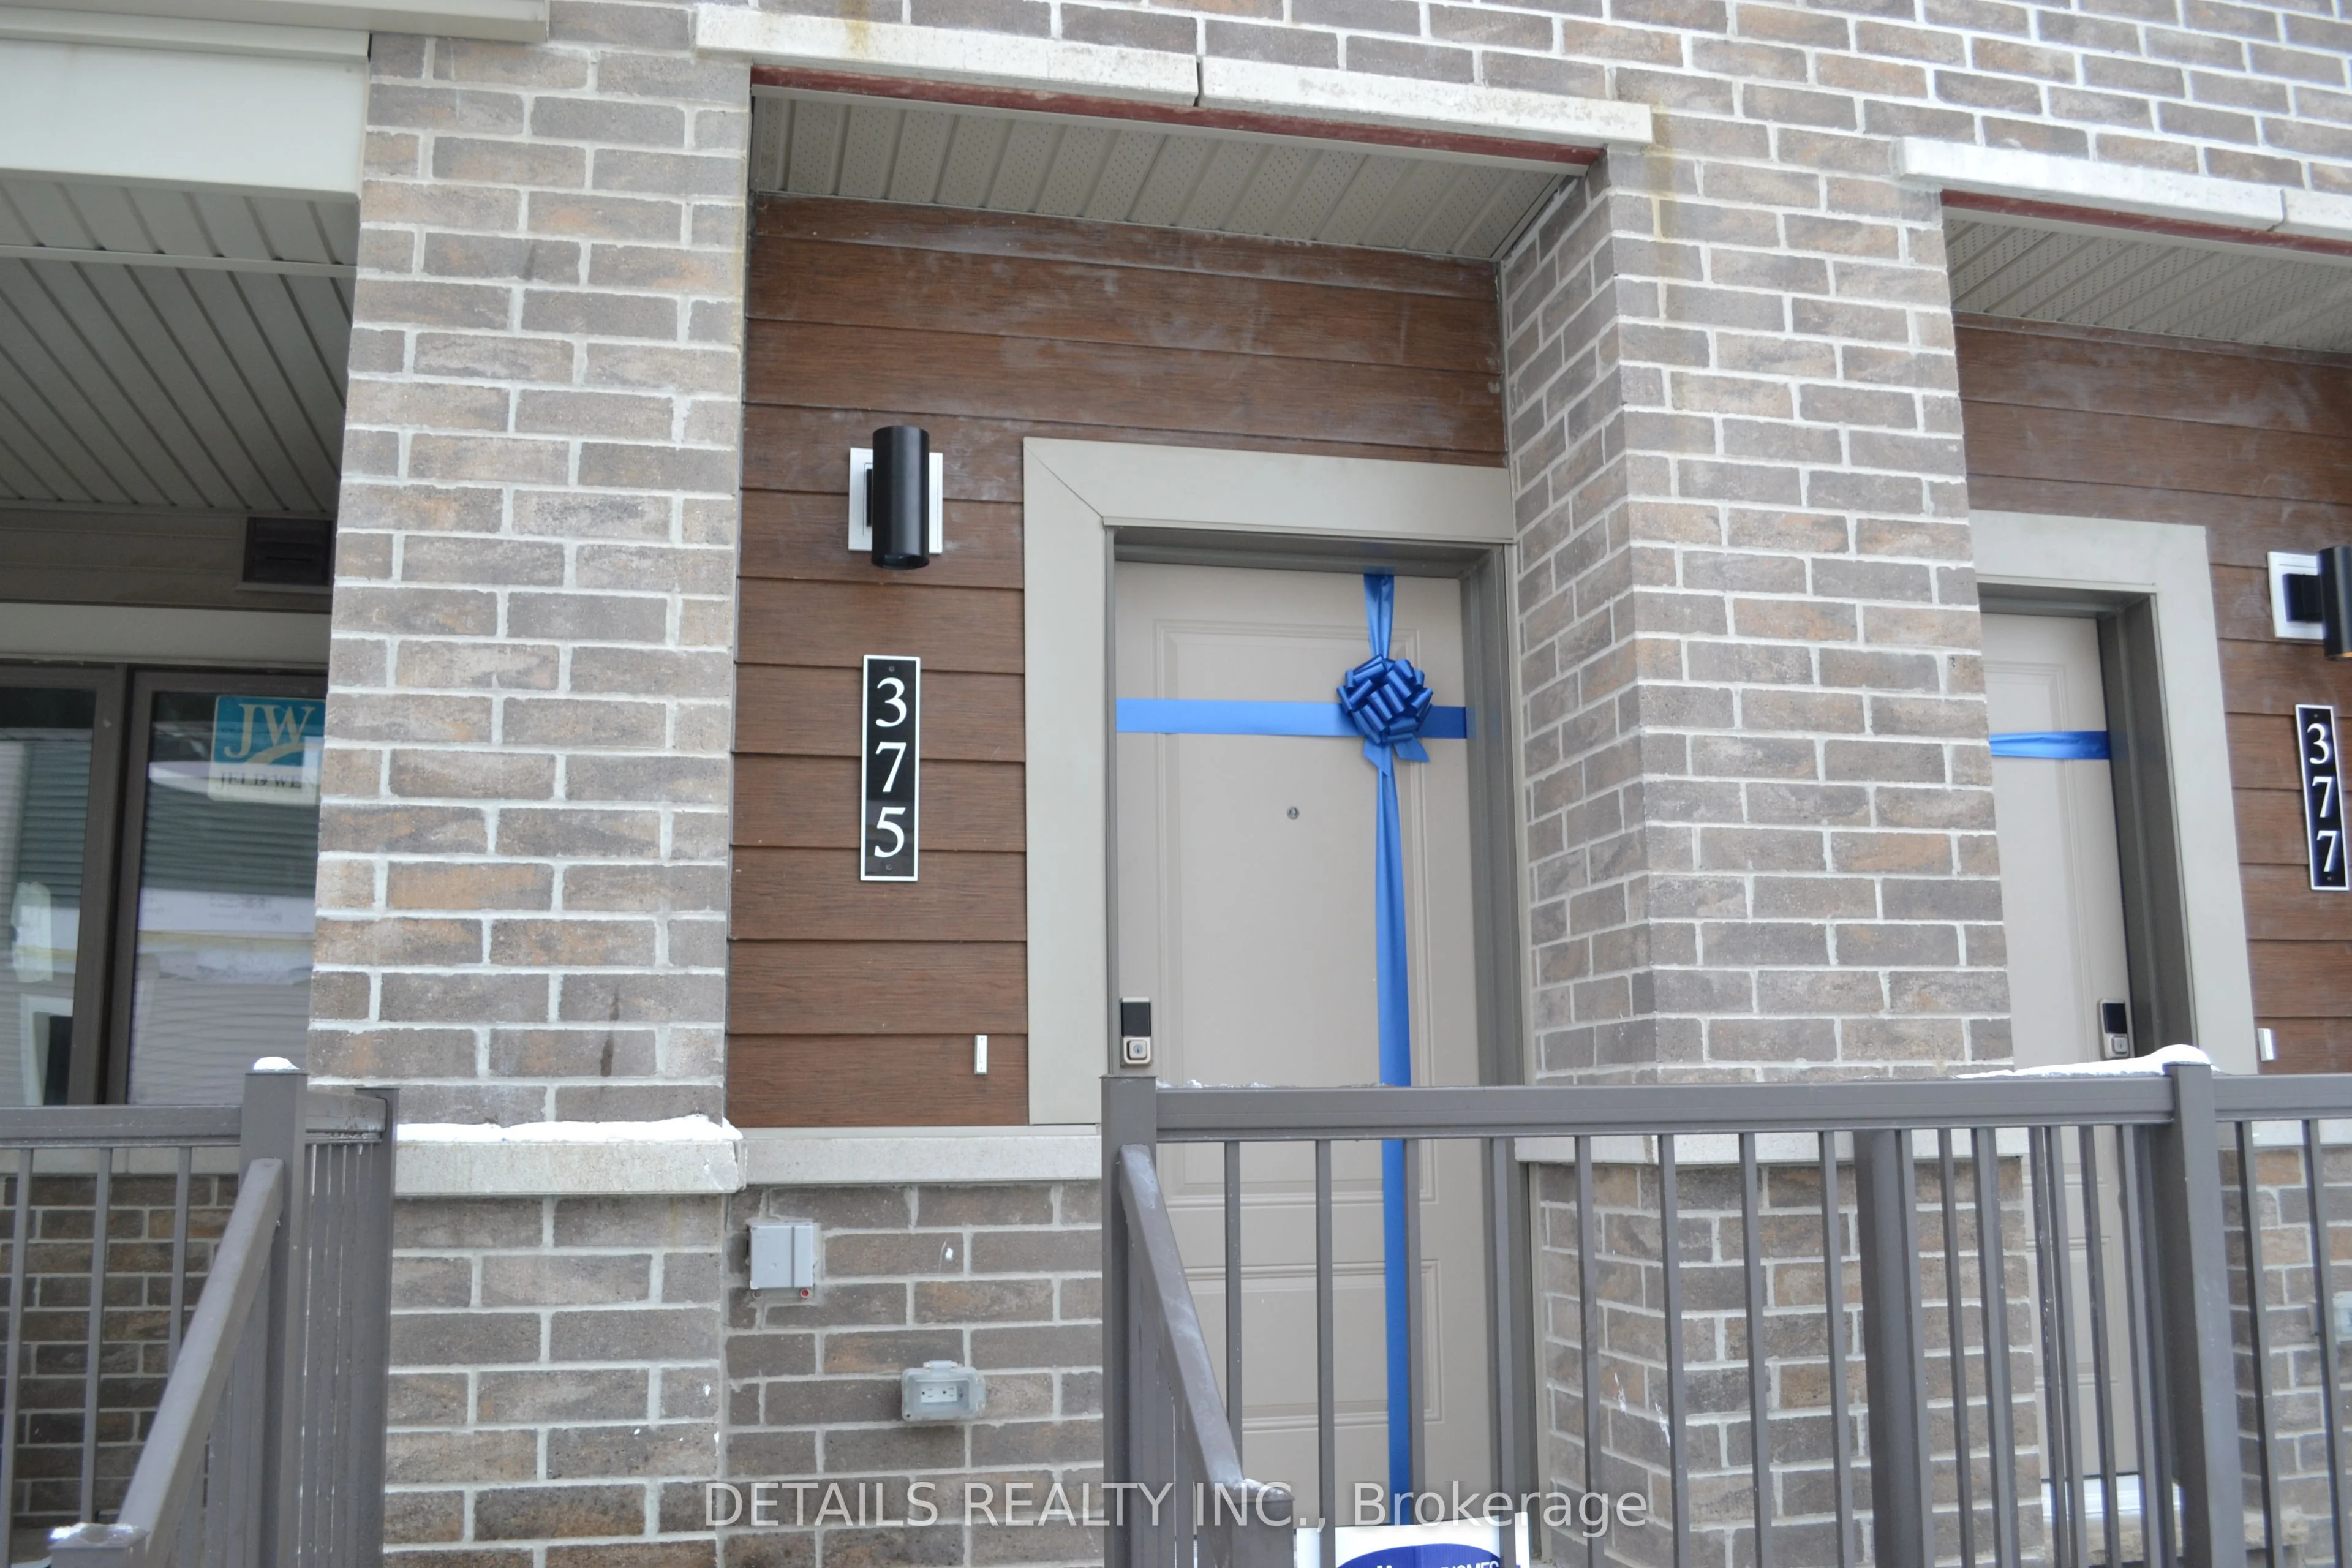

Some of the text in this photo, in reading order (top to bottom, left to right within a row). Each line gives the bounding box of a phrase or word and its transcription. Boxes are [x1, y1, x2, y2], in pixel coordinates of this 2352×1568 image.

[224, 703, 315, 758] JW
[874, 677, 907, 858] 375
[2307, 723, 2337, 872] 377
